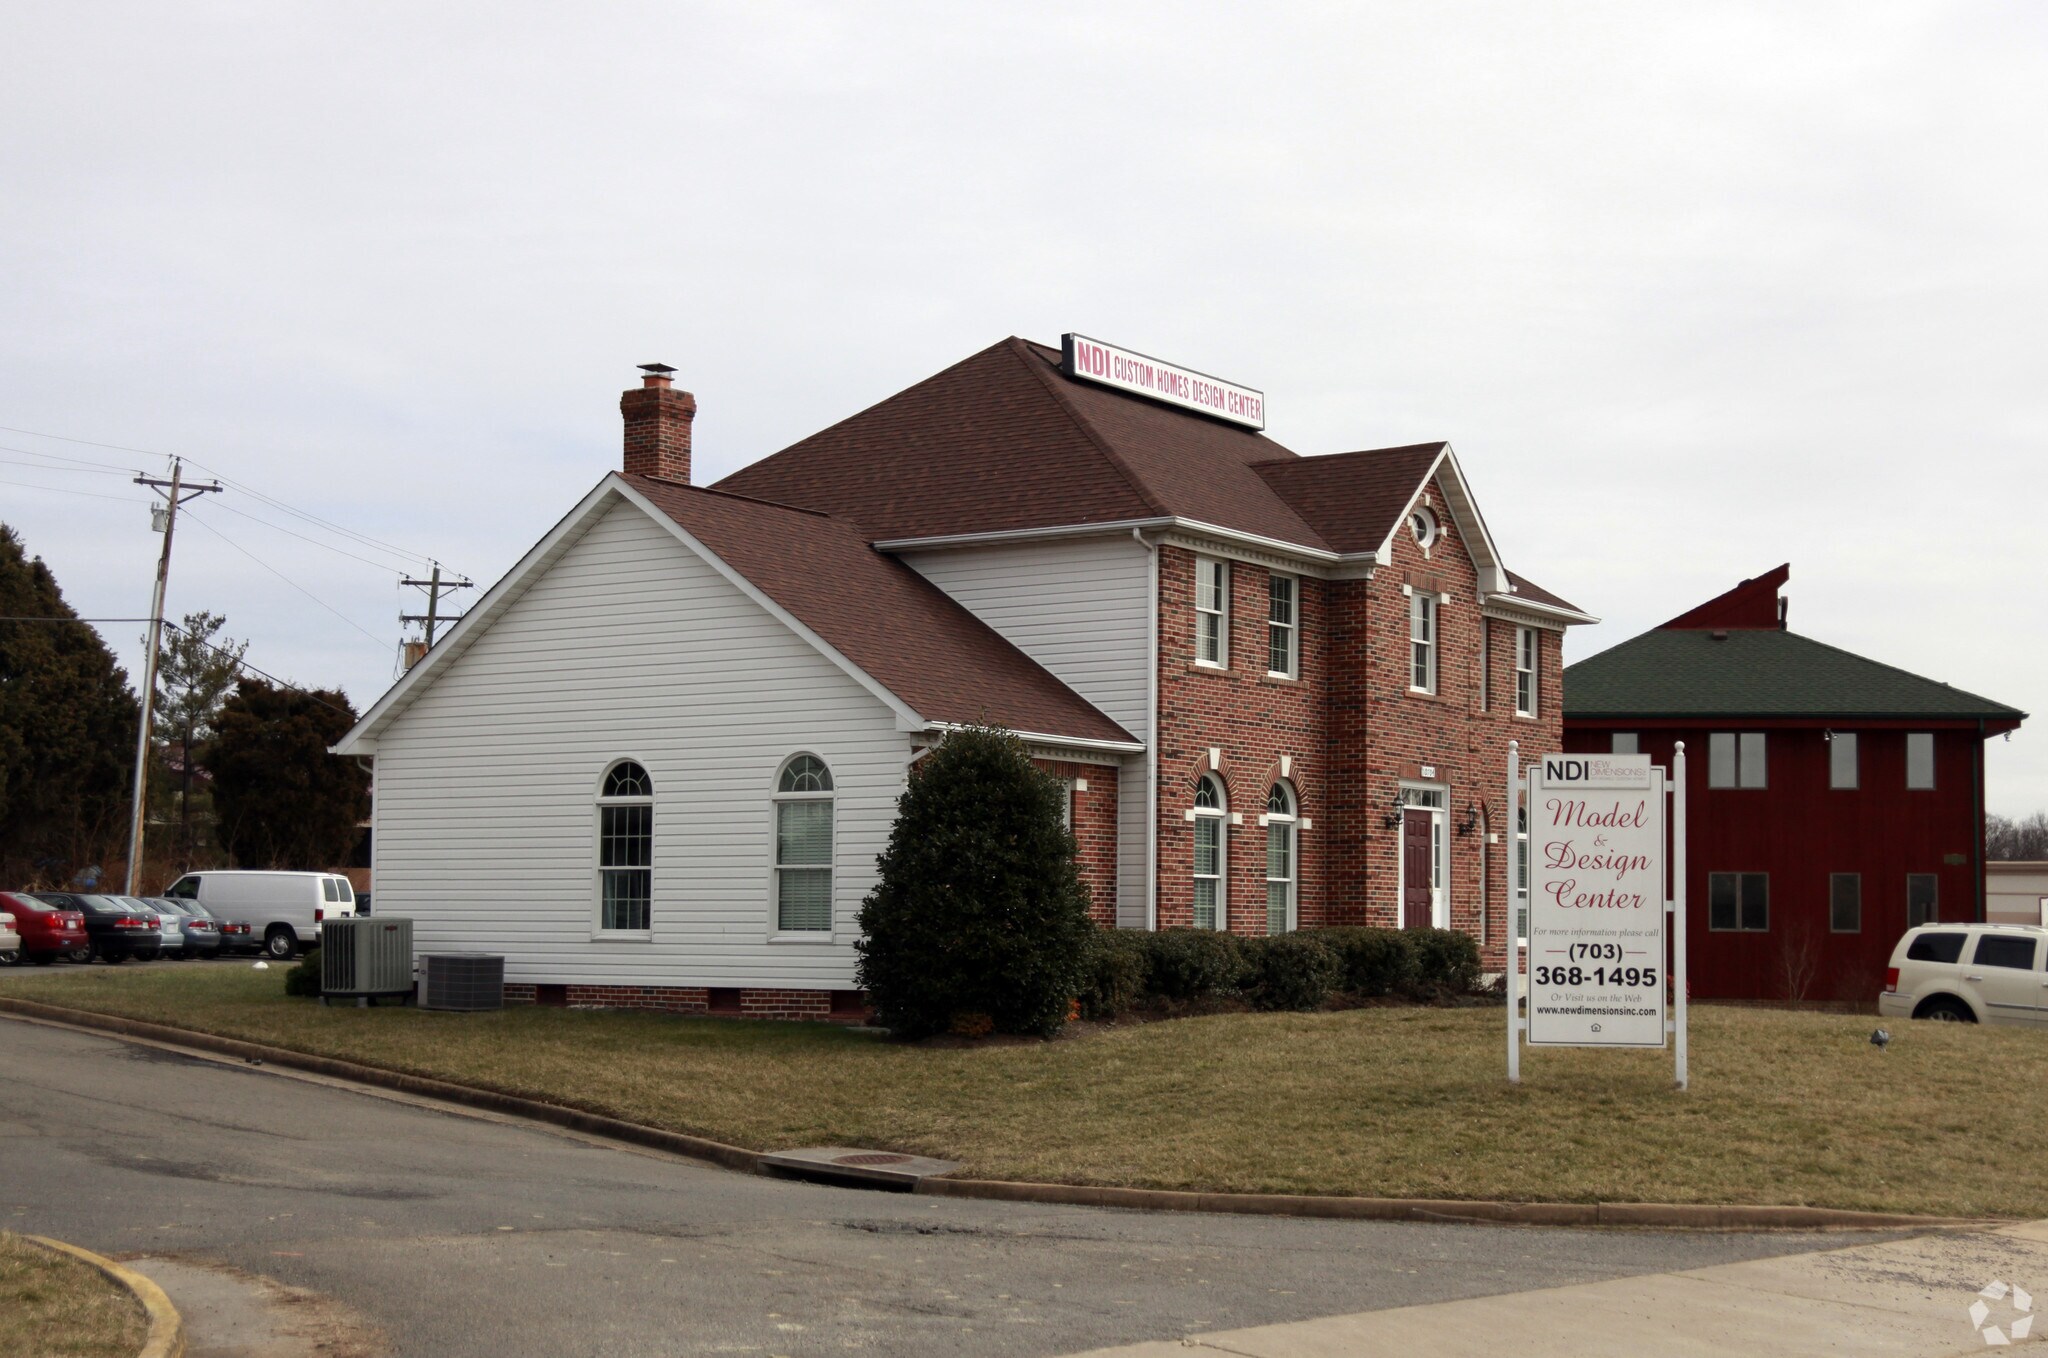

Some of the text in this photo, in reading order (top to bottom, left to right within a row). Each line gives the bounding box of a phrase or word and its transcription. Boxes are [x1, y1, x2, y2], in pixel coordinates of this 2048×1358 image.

[1077, 341, 1261, 421] NDI CUSTOM HOMES DESIGN CENTER
[1547, 761, 1589, 780] NDI
[1590, 760, 1611, 768] NEW
[1590, 768, 1643, 776] DIMENSIONS
[1546, 799, 1648, 828] Model
[1594, 834, 1608, 847] &
[1545, 840, 1653, 881] Design
[1545, 879, 1647, 908] Center
[1533, 927, 1659, 939] For more information please call
[1569, 943, 1623, 963] (703)
[1535, 966, 1657, 987] 368-1495
[1551, 993, 1563, 1001] Or
[1565, 993, 1584, 1001] Visit
[1610, 994, 1623, 1002] the
[1624, 994, 1642, 1003] Web
[1536, 1005, 1657, 1016] www.newdimensionsinc.com
